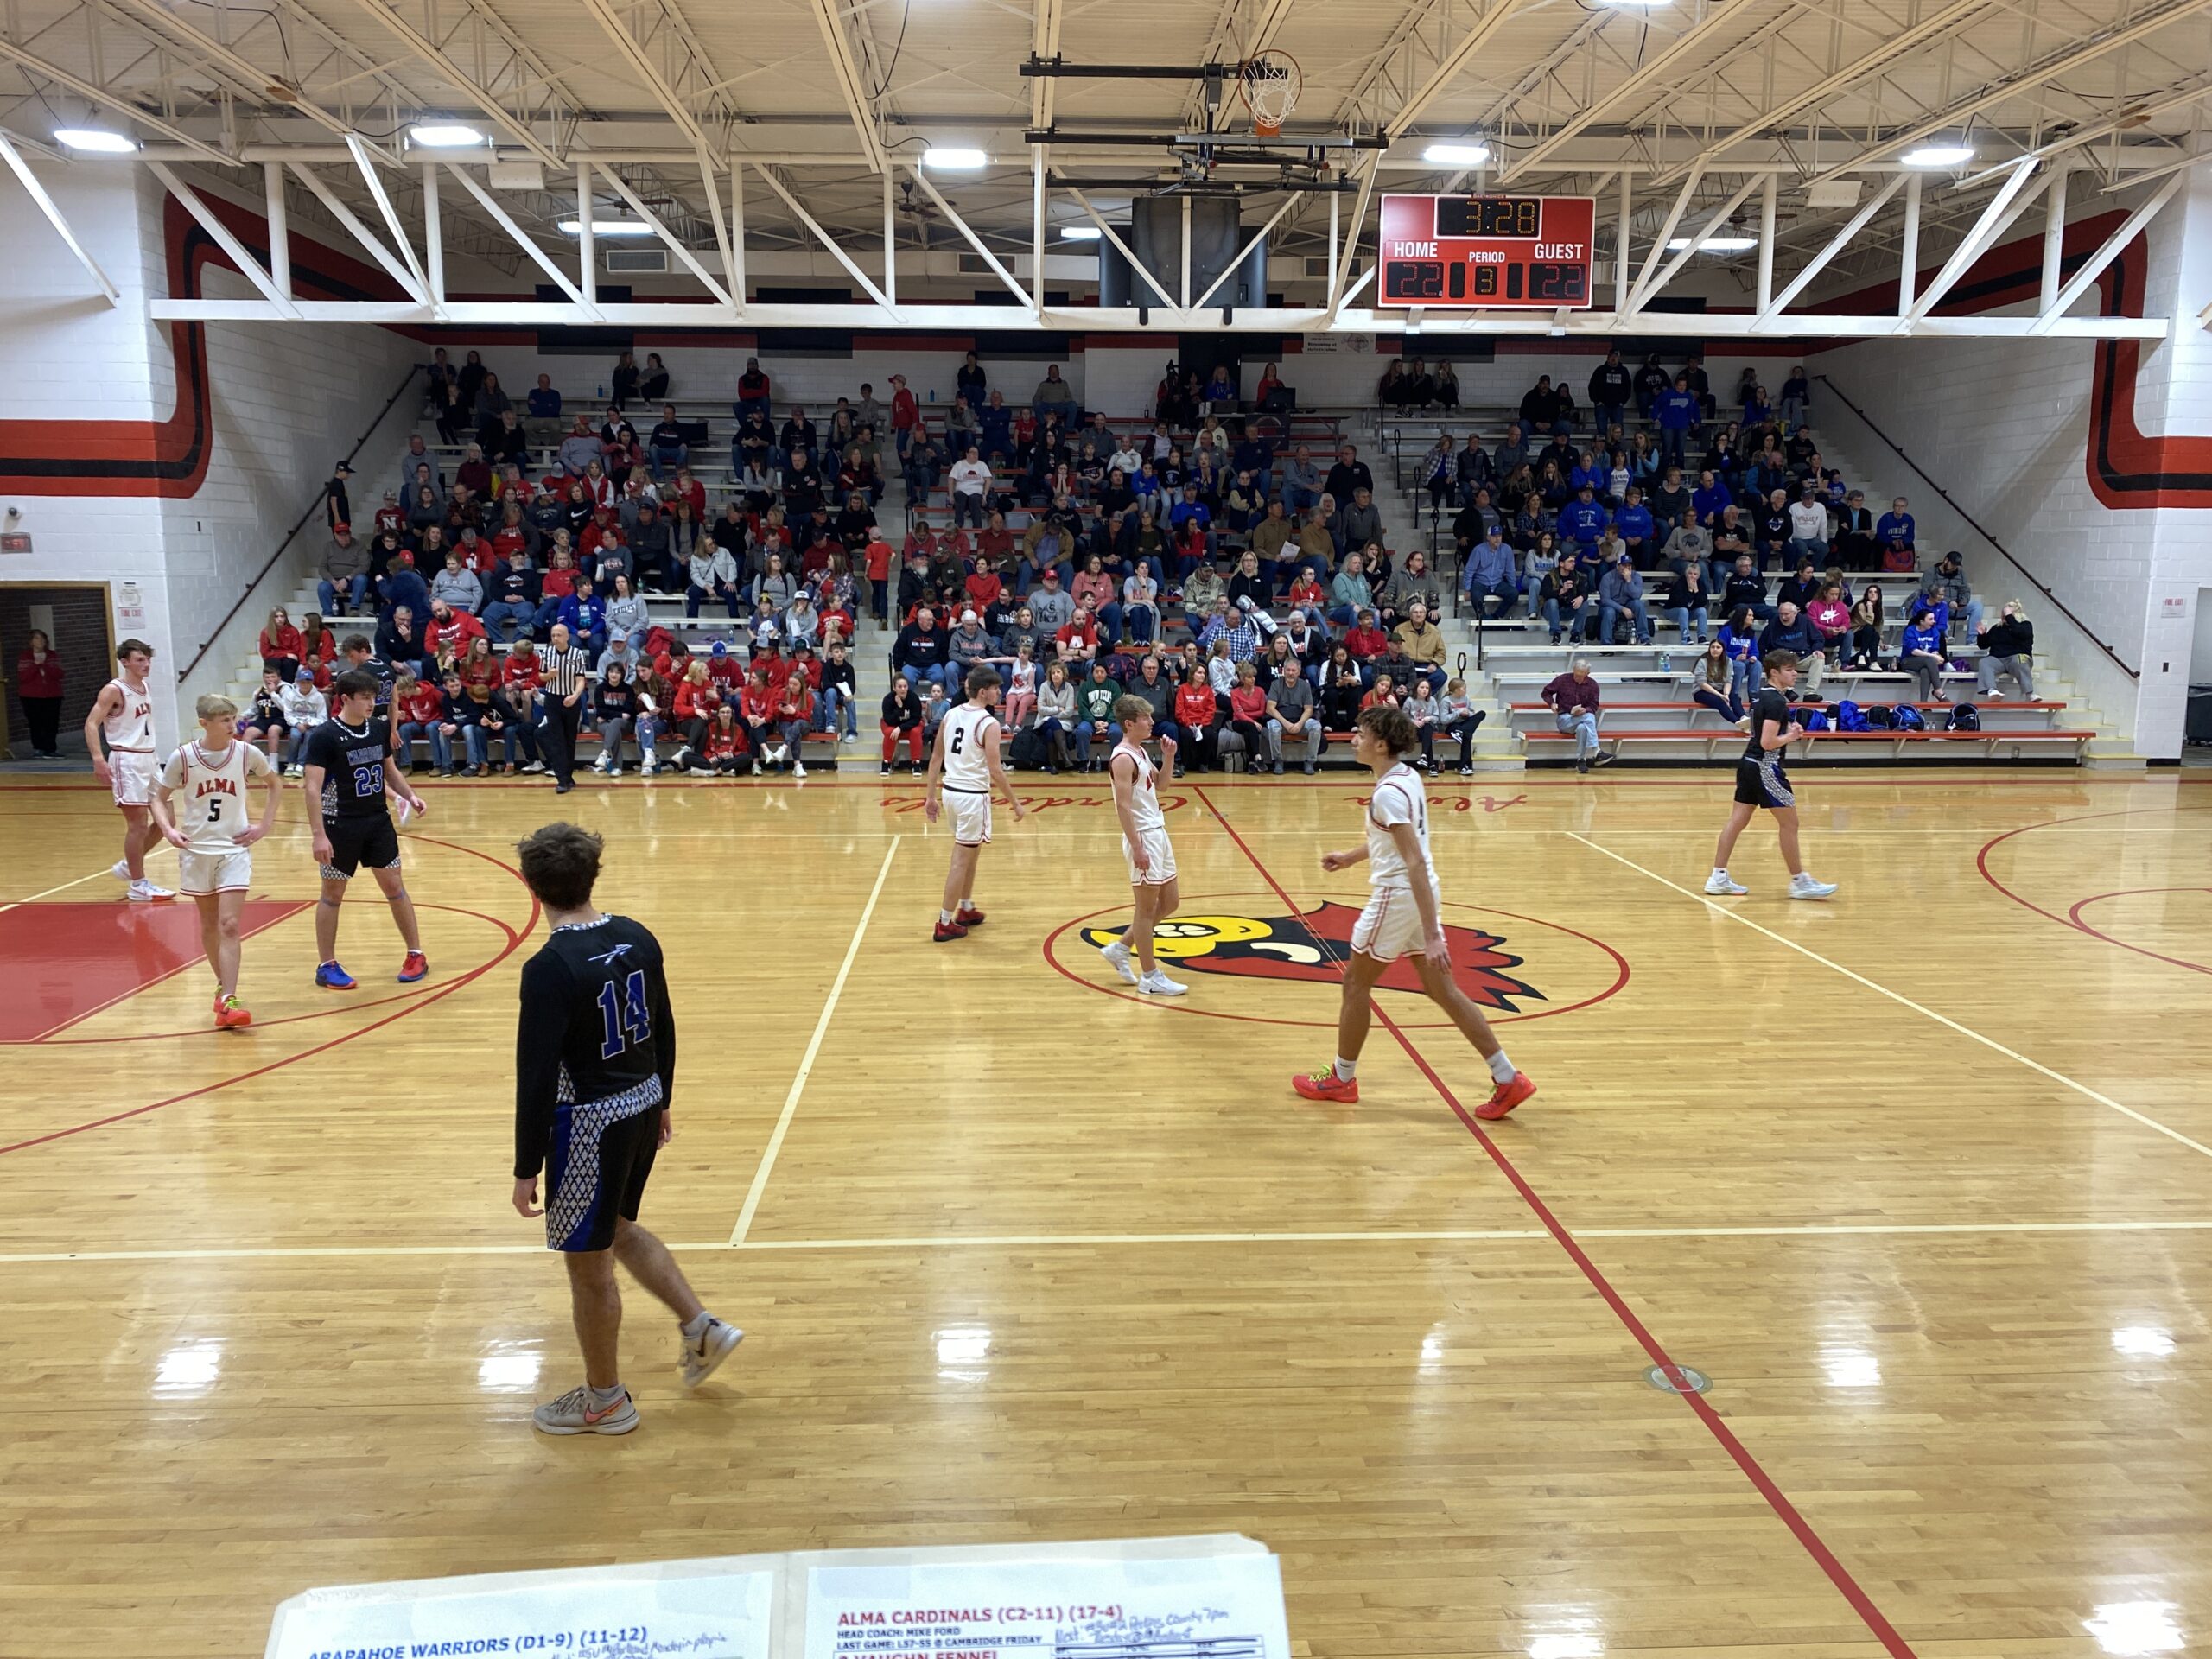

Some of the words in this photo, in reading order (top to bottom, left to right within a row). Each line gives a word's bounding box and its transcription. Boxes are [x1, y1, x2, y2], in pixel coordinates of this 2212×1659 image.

[1465, 200, 1535, 234] 3:28
[1394, 241, 1438, 258] HOME
[1469, 251, 1505, 264] PERIOD
[1535, 243, 1584, 260] GUEST
[1400, 264, 1441, 296] 22
[1480, 268, 1494, 293] 3
[1541, 264, 1583, 297] 22
[612, 604, 637, 616] EAGLES
[951, 727, 965, 754] 2
[195, 778, 238, 798] ALMA
[353, 763, 383, 797] 23
[207, 798, 222, 822] 5
[596, 969, 651, 1061] 14
[837, 1611, 887, 1626] ALMA
[892, 1608, 993, 1626] CARDINALS
[997, 1605, 1063, 1625] (C2-11)
[1068, 1604, 1123, 1623] (17-4)
[411, 1637, 510, 1658] WARRIORS
[514, 1631, 573, 1653] (D1-9)
[580, 1626, 647, 1649] (11-12)
[836, 1641, 861, 1650] LAST
[863, 1640, 895, 1649] GAME:
[944, 1637, 1003, 1648] CAMBRIDGE
[1005, 1635, 1043, 1645] FRIDAY
[837, 1630, 864, 1639] HEAD
[906, 1627, 931, 1637] MIKE
[934, 1627, 961, 1637] FORD
